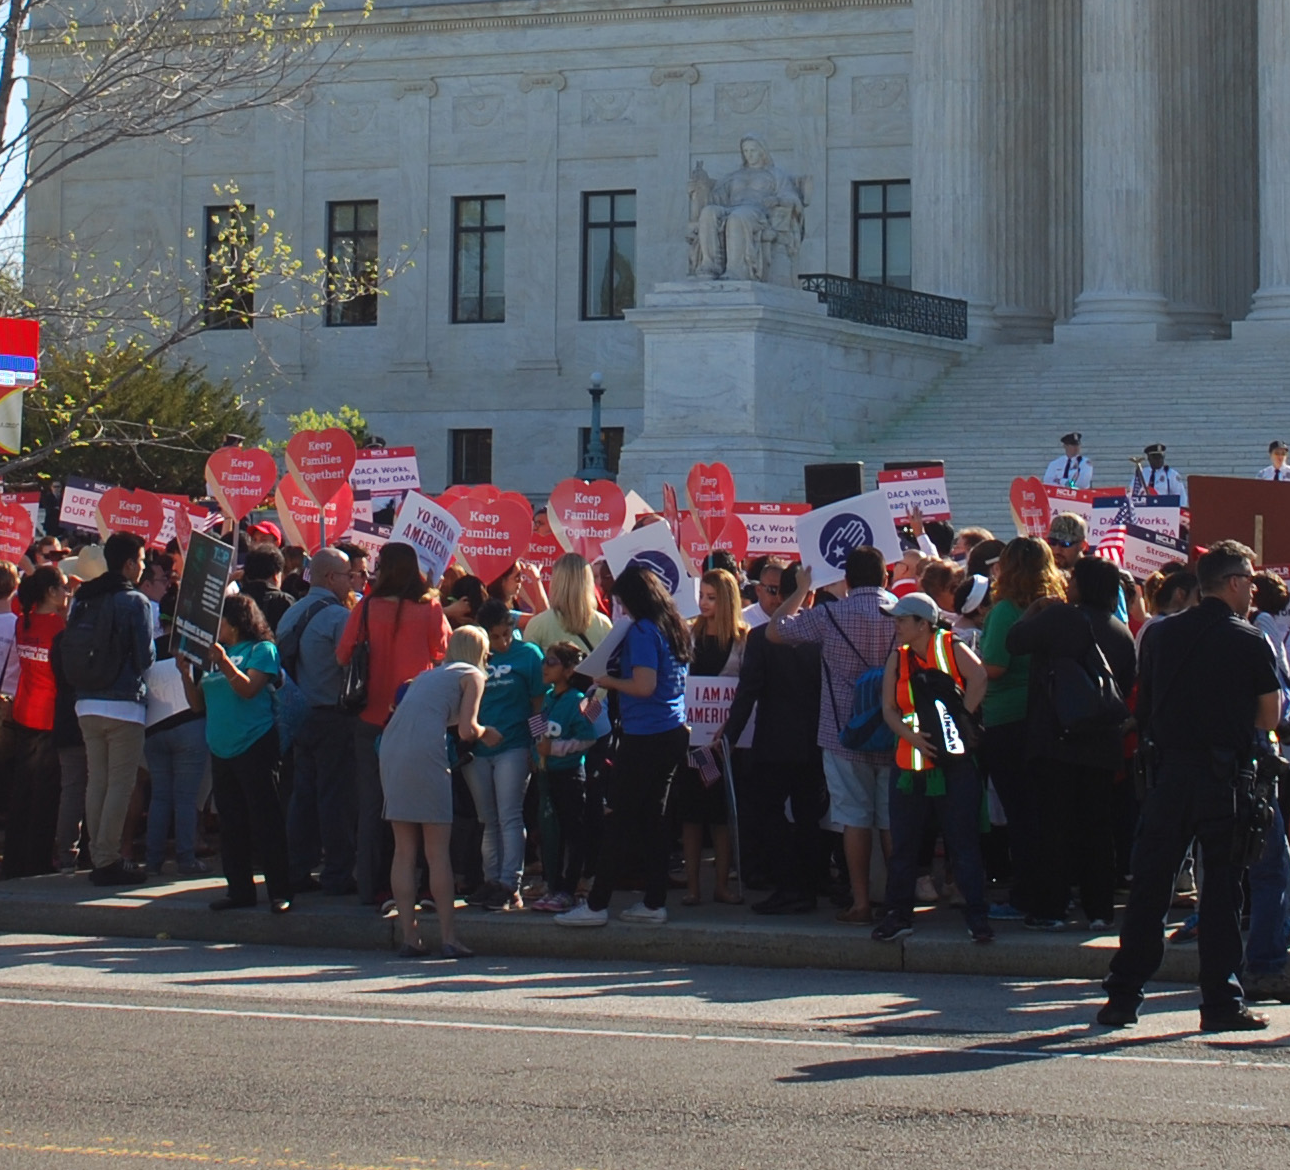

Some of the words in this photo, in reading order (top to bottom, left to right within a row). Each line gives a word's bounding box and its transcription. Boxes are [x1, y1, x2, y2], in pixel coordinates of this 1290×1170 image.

[308, 441, 332, 452] Keep
[370, 449, 388, 457] NCLR
[230, 458, 254, 468] Keep
[300, 455, 342, 466] Families
[355, 467, 379, 475] DACA
[381, 465, 411, 474] Works,
[902, 470, 918, 478] NCLR
[221, 472, 261, 482] Families
[379, 476, 390, 484] for
[393, 474, 417, 482] DAPA
[700, 477, 717, 488] Keep
[695, 491, 725, 502] Families
[887, 491, 910, 499] DACA
[912, 488, 940, 497] Works,
[1056, 488, 1077, 497] NCLR
[72, 495, 97, 507] DEFE
[574, 493, 601, 506] Keep
[889, 502, 909, 511] eady
[924, 497, 946, 507] DAPA
[1132, 496, 1147, 504] CLR
[64, 507, 86, 516] OUR
[118, 500, 142, 513] Keep
[760, 504, 781, 513] NCLR
[109, 514, 149, 527] Families
[469, 511, 500, 525] Keep
[564, 509, 609, 521] Families
[416, 507, 430, 523] YO
[431, 516, 448, 536] SOY
[562, 526, 611, 539] Together!
[769, 524, 795, 532] Work
[459, 527, 510, 541] Families
[1155, 534, 1177, 546] NCLR
[457, 543, 512, 557] Together!
[529, 543, 556, 553] Keep
[695, 687, 699, 700] I
[703, 687, 720, 700] AM
[687, 707, 730, 723] AMERIC
